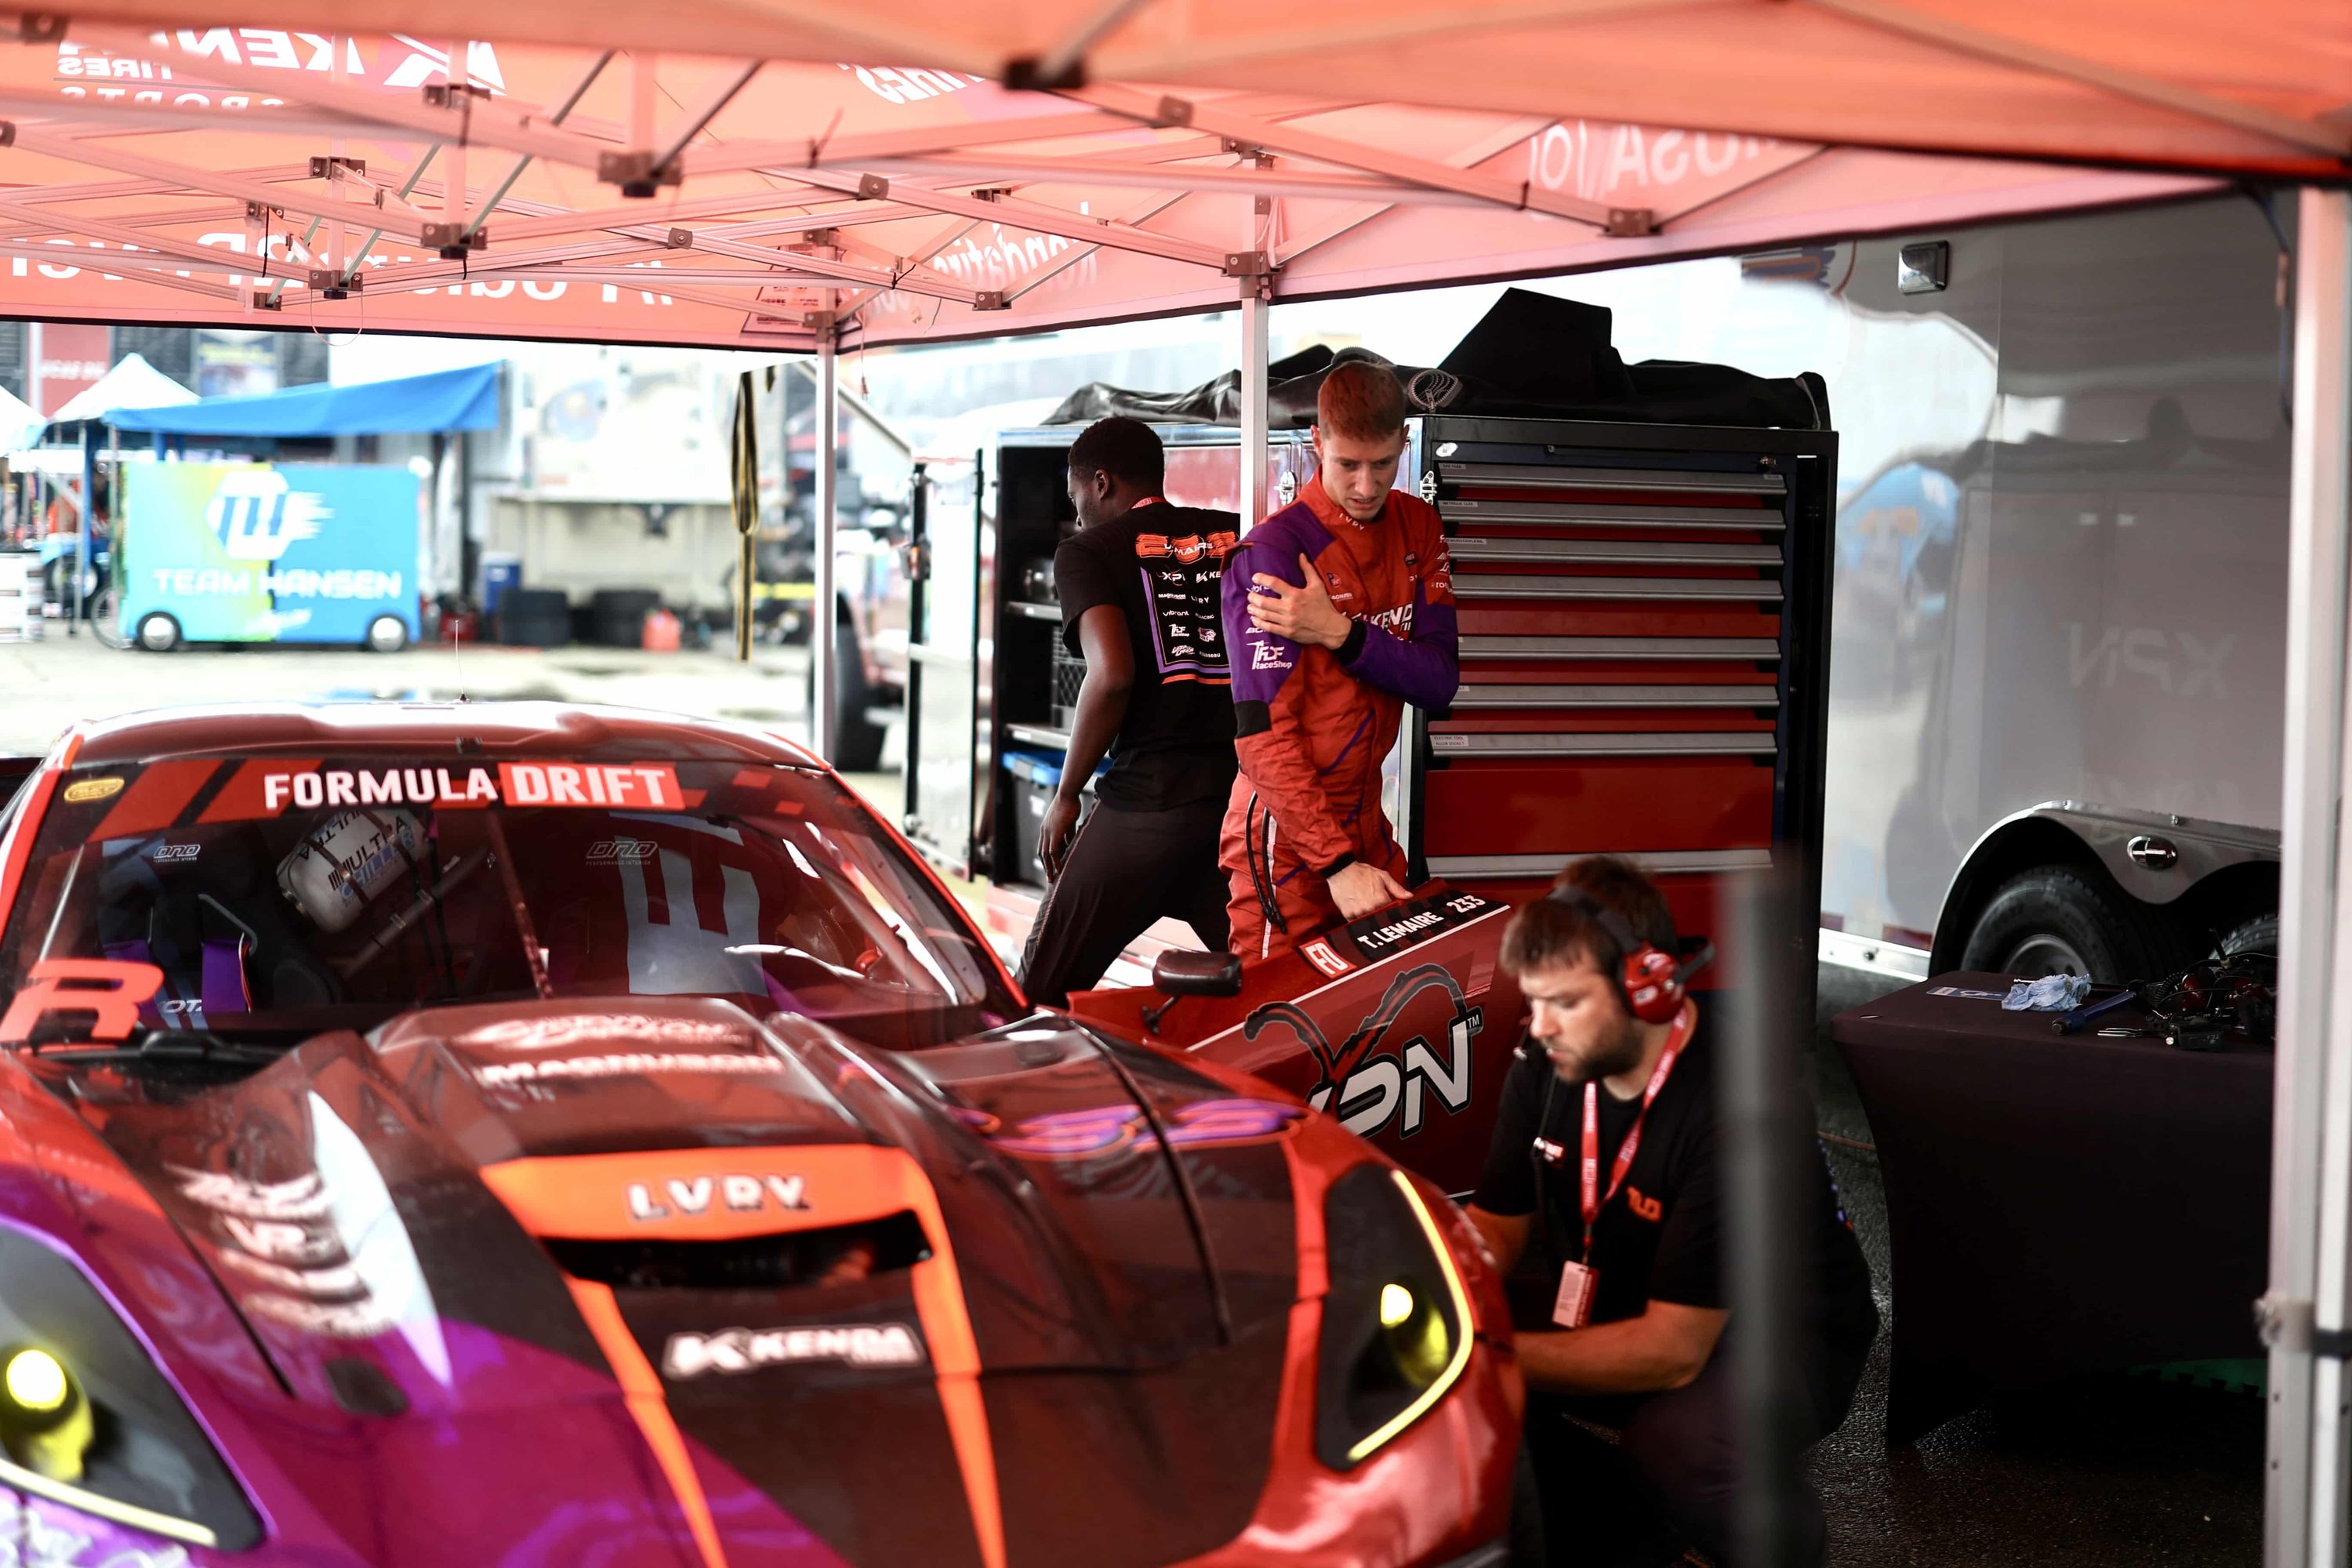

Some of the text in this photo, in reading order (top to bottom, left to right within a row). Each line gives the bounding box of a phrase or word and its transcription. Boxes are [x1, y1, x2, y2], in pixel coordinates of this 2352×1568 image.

[152, 568, 402, 599] TEAM HANSEN
[263, 765, 674, 809] FORMULA DRIFT
[1446, 895, 1486, 913] 233
[628, 1174, 811, 1221] LVRY
